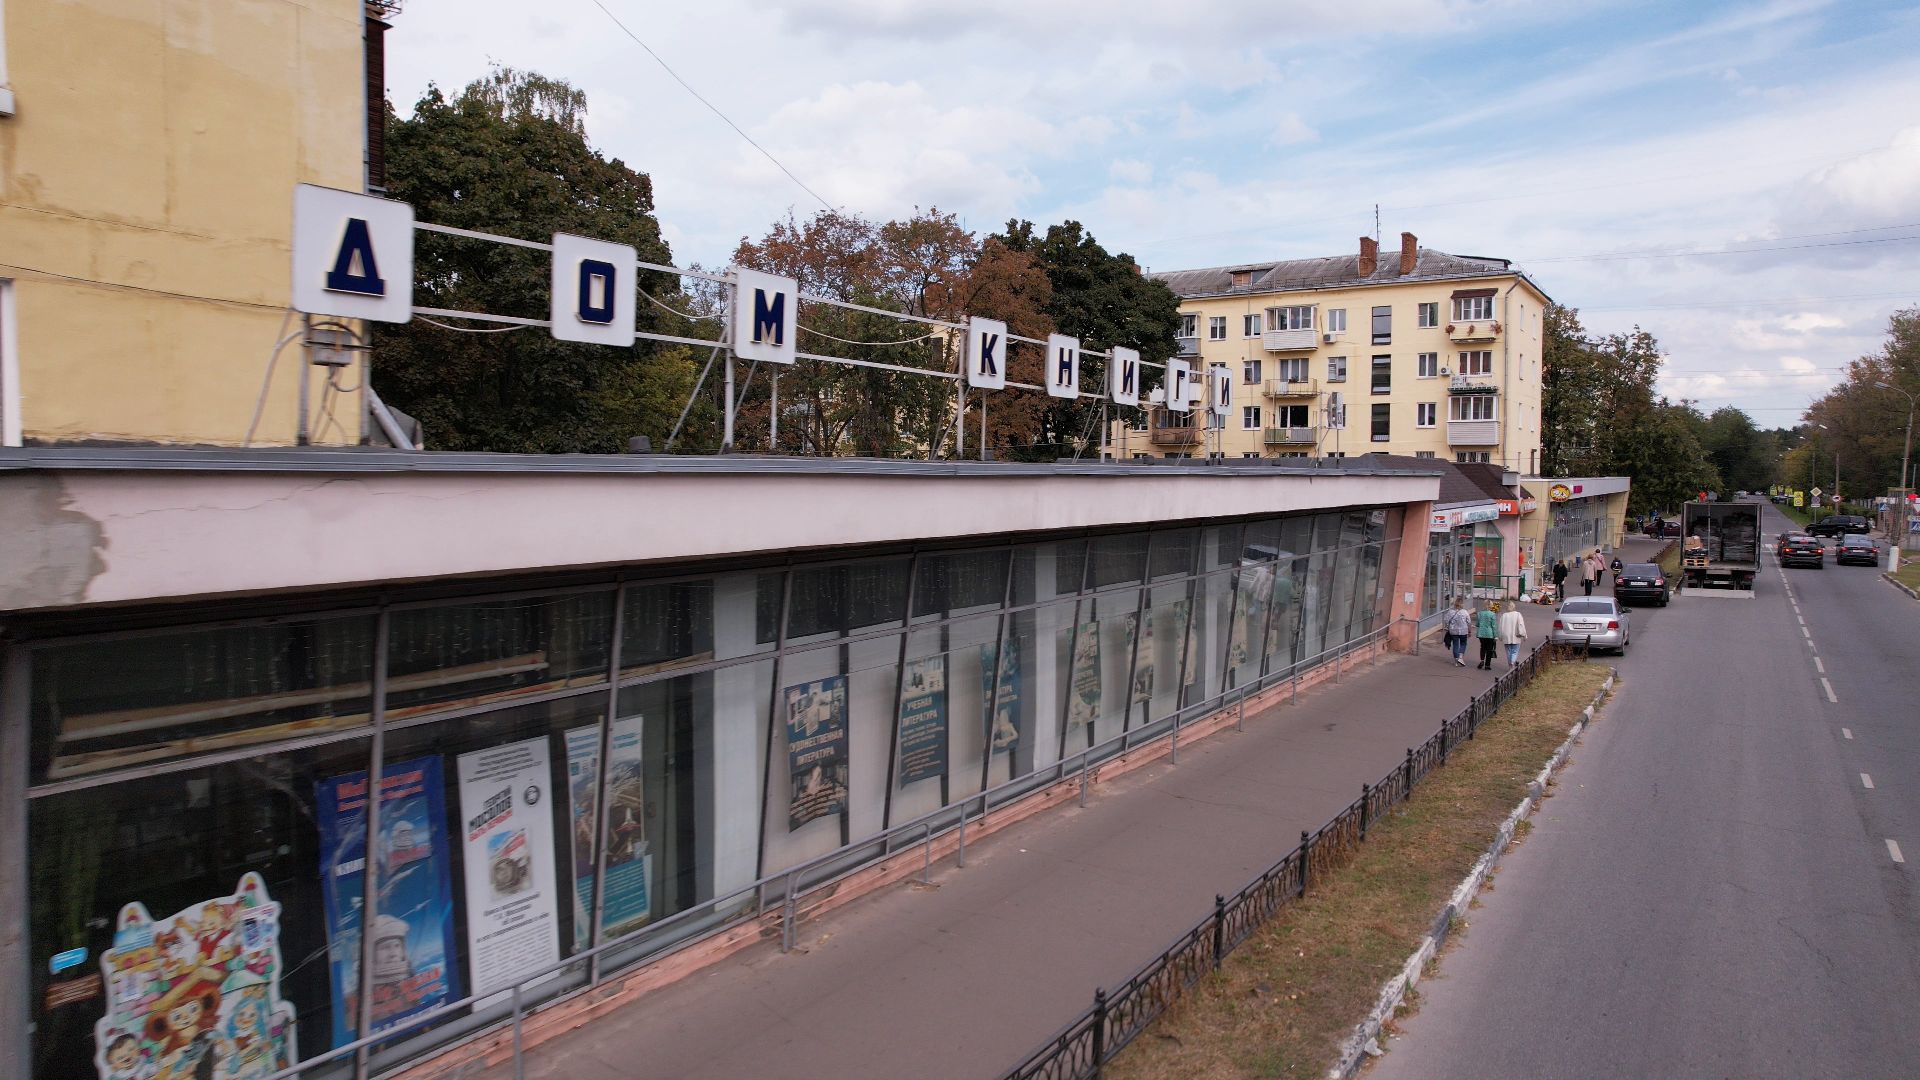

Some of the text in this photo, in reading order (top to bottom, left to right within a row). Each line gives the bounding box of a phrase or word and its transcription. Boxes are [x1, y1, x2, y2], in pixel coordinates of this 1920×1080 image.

[324, 217, 1230, 406] ДОМ КНИГИ
[902, 710, 938, 727] ЛИТЕРАТУРА
[796, 746, 835, 766] ЛИТЕРАТУРА
